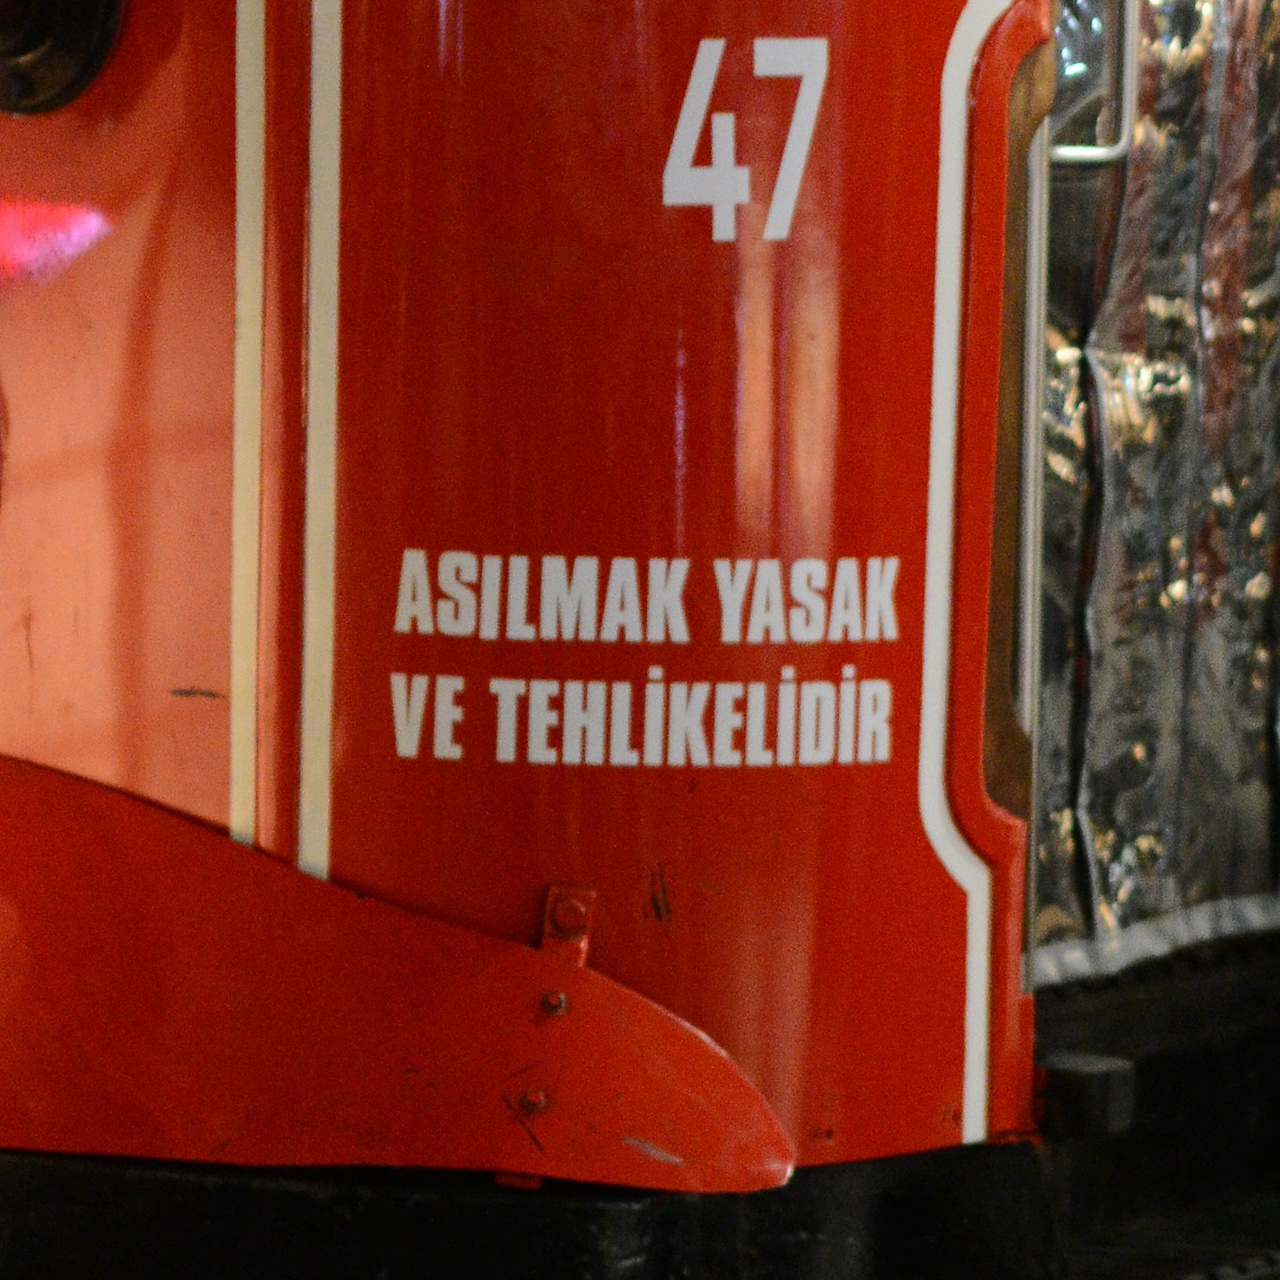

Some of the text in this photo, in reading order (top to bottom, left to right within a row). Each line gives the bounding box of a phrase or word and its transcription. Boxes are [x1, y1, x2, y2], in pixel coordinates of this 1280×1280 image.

[662, 36, 829, 242] 47
[394, 549, 900, 645] ASILMAK YASAK
[390, 665, 892, 767] VE TEHLİKELİDİR
